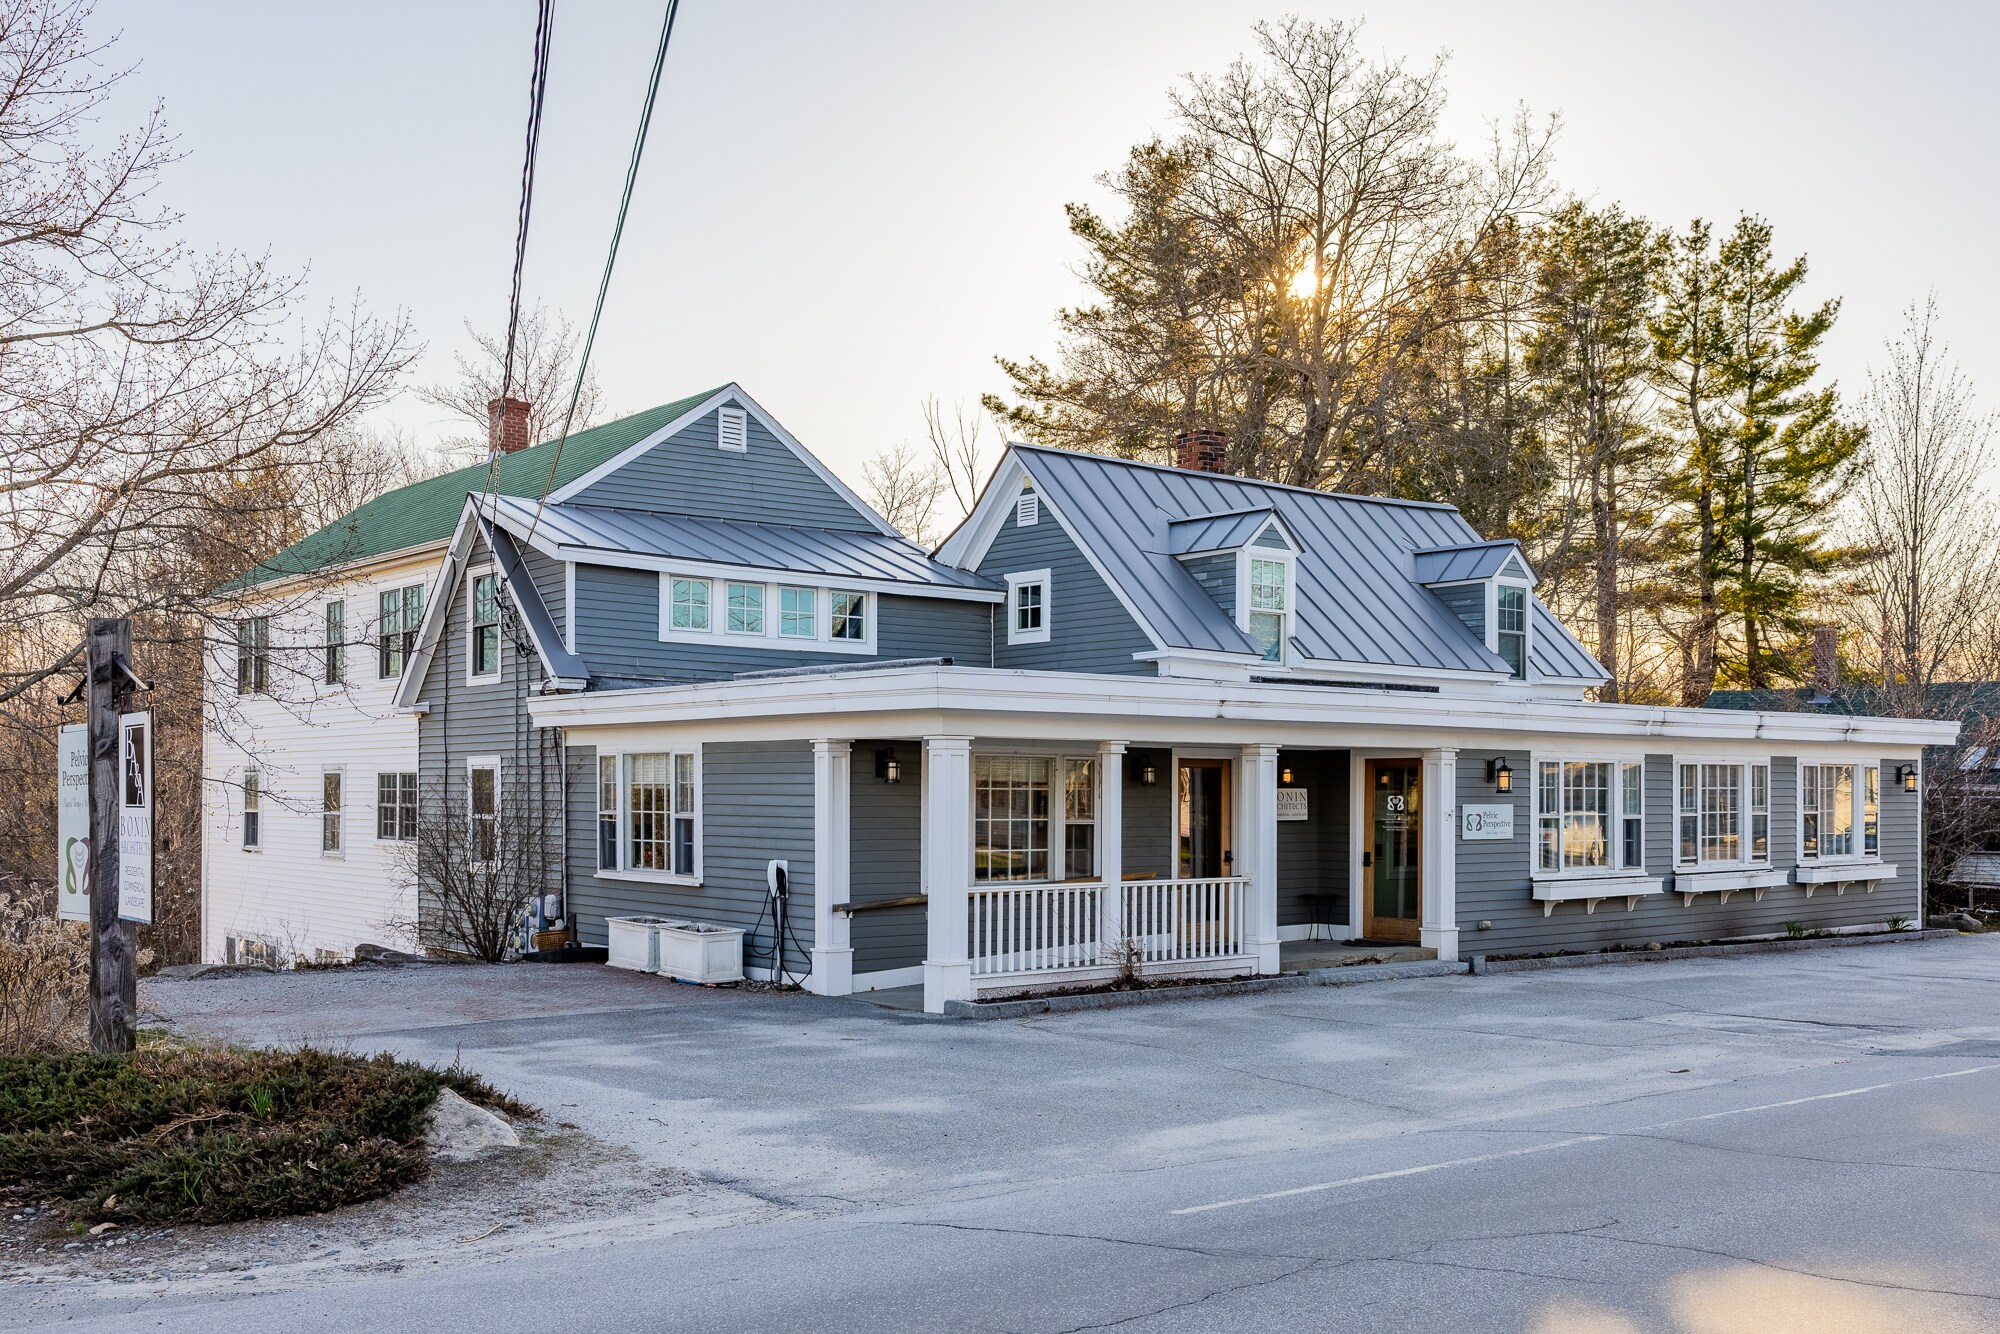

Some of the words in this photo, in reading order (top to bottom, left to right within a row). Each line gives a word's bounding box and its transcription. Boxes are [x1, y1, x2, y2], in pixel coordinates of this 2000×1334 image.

[70, 749, 88, 767] Pelvic
[62, 770, 88, 791] Perspect
[1277, 792, 1307, 802] ONIN
[1277, 802, 1307, 810] CHITECTS
[1482, 810, 1498, 819] Pelvic
[120, 815, 151, 837] BONIN
[1482, 819, 1512, 830] Perspective
[119, 840, 151, 856] ARCHITECTS
[125, 865, 145, 878] RESIDENTIAL
[123, 880, 146, 894] COMMERCIAL
[125, 896, 145, 909] LANDSCAPE
